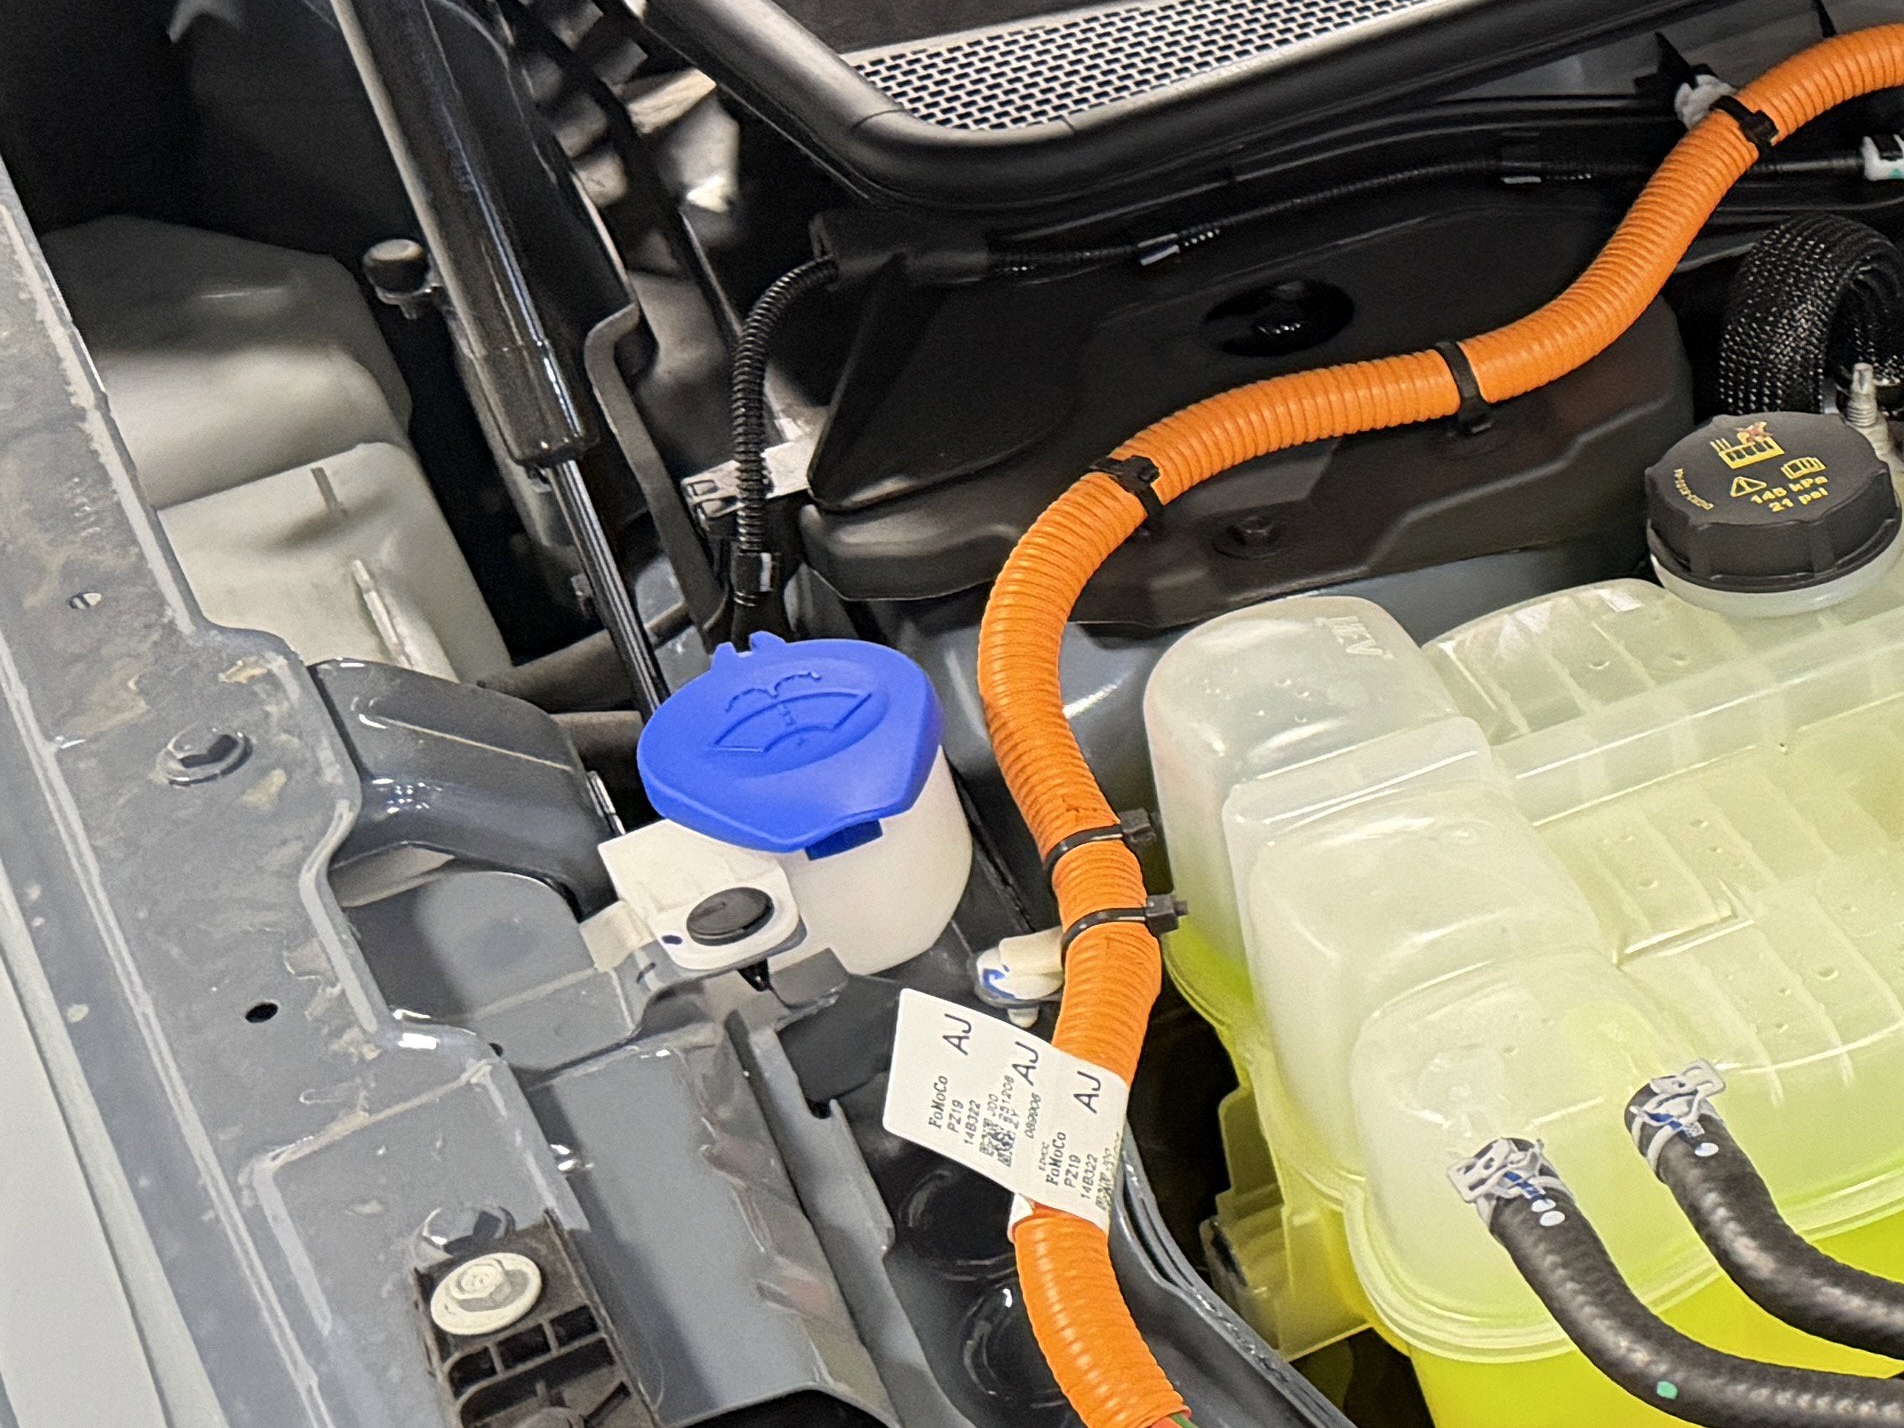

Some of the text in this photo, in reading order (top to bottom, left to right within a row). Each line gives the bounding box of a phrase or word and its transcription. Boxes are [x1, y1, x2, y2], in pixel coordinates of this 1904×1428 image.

[1769, 487, 1829, 512] 21 psi
[1788, 476, 1829, 493] kPa
[942, 1013, 972, 1056] AJ
[1012, 1041, 1039, 1086] AJ
[929, 1075, 948, 1129] FoMoCo
[1073, 1071, 1101, 1114] AJ
[948, 1100, 964, 1133] PZ19
[964, 1100, 981, 1145] 14B322
[1046, 1132, 1066, 1186] FoMoCo
[1064, 1155, 1081, 1188] PZ19
[1081, 1153, 1098, 1200] 14B322
